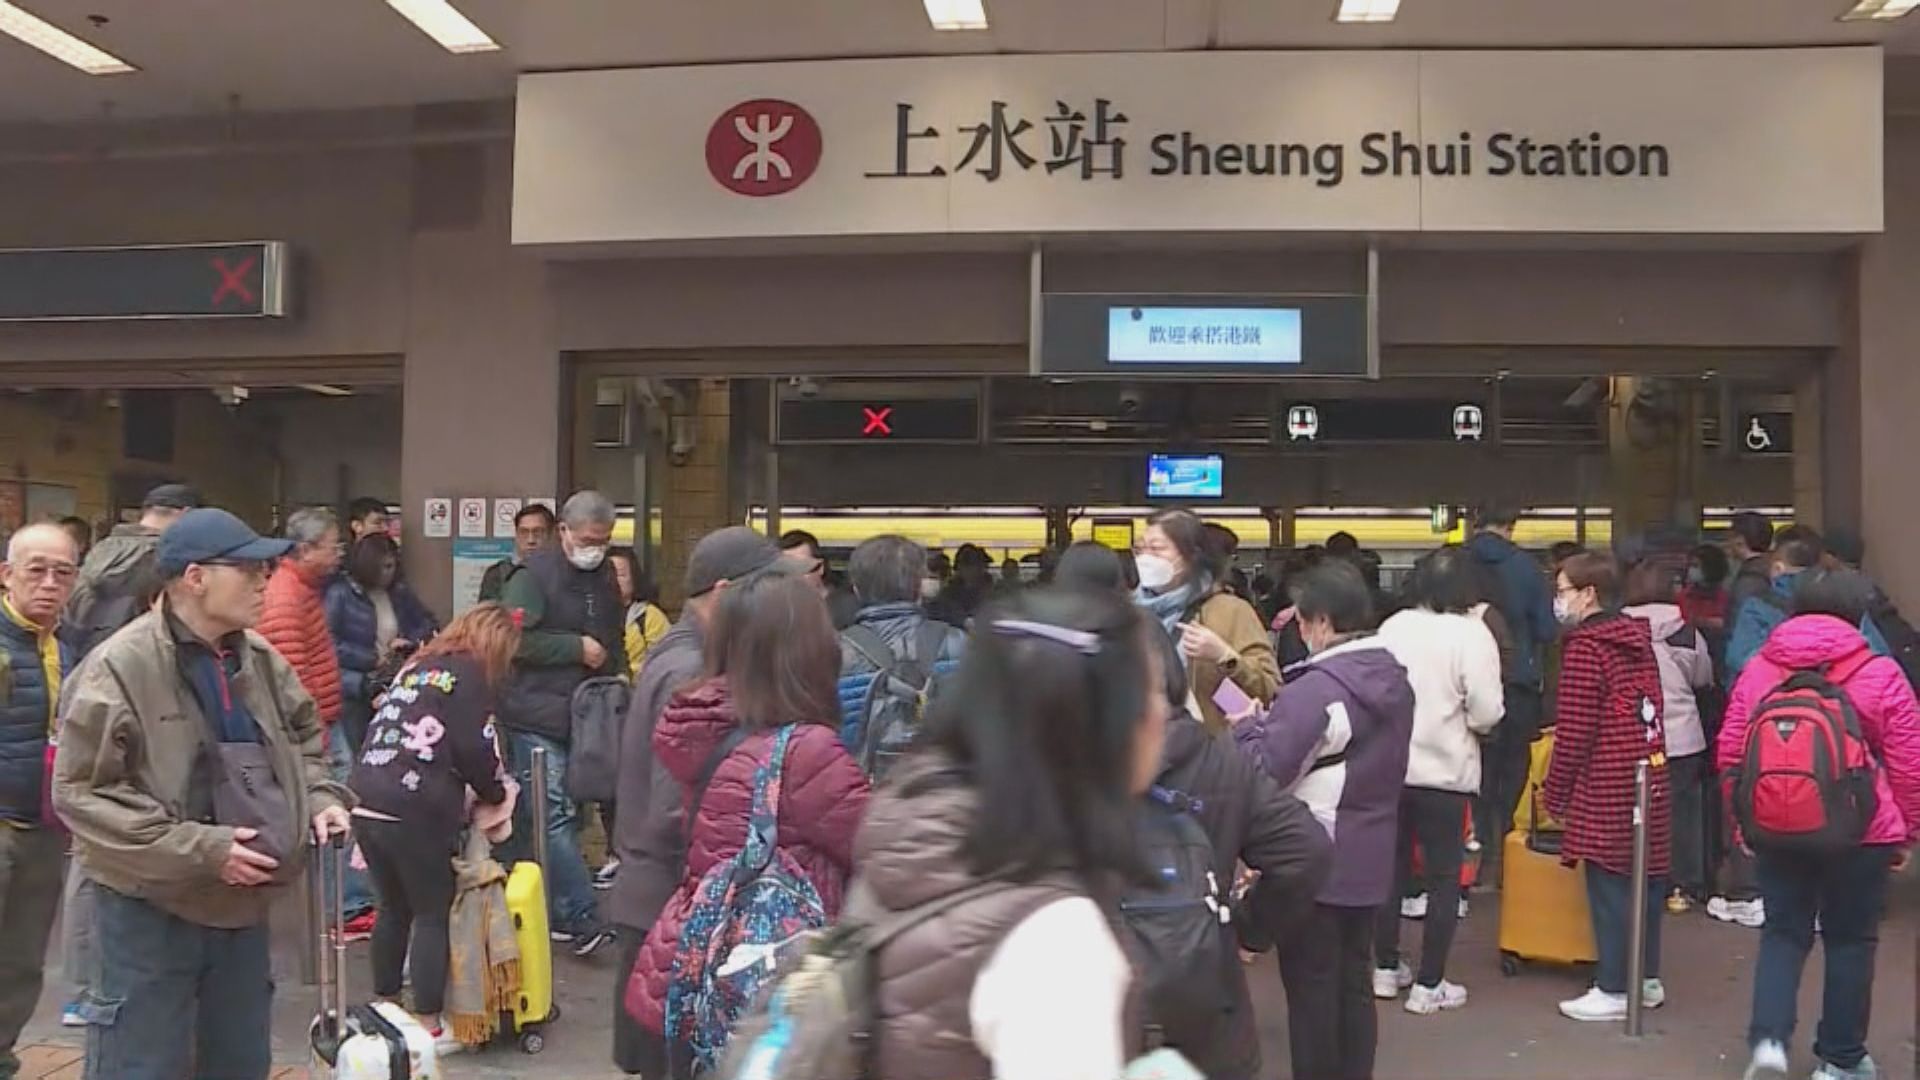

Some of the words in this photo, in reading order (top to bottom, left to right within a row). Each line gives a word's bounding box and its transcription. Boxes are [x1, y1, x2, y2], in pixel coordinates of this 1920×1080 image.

[864, 98, 1128, 184] 上水站
[1150, 131, 1344, 187] Sheung
[1359, 131, 1471, 175] Shui
[1486, 131, 1670, 176] Station
